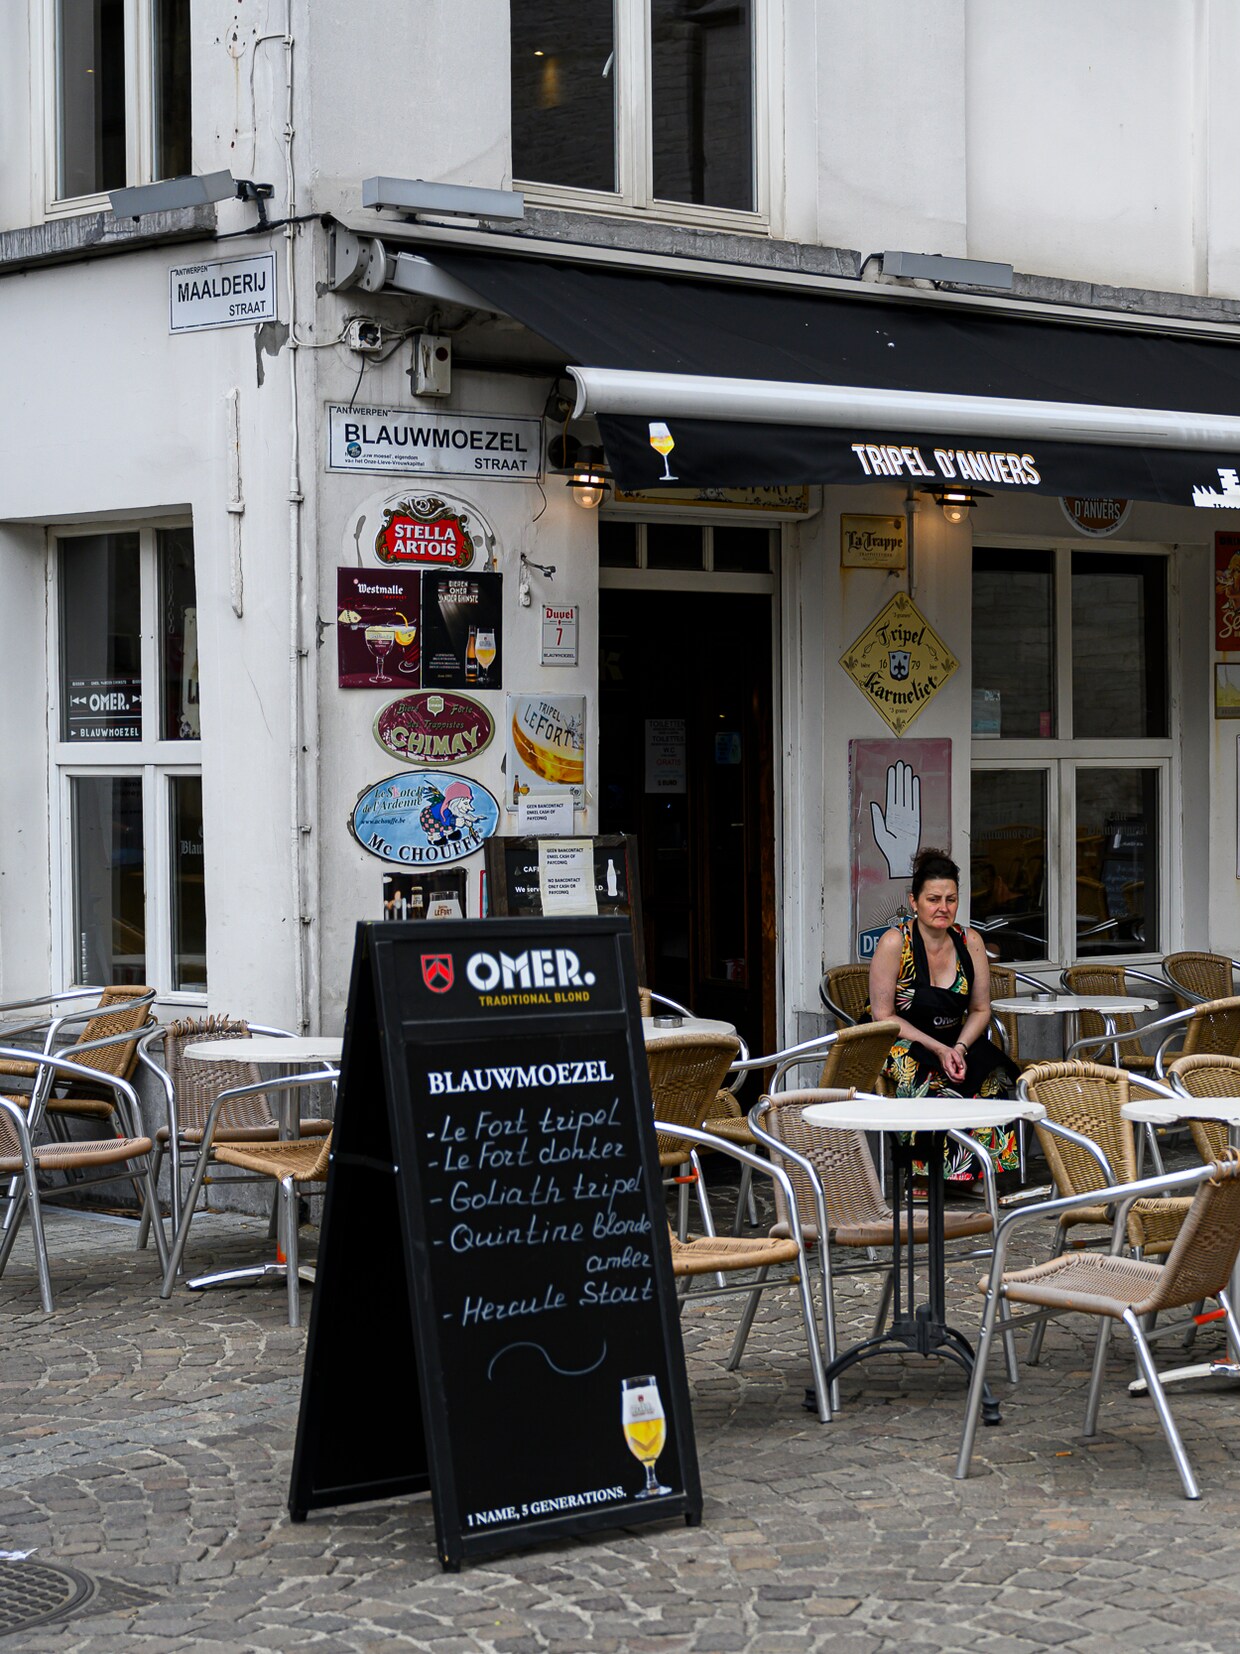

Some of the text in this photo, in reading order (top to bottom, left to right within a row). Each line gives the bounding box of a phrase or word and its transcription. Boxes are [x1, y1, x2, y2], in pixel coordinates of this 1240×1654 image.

[175, 264, 208, 277] ANTWERPEN
[178, 271, 266, 303] MAALDERIJ
[229, 300, 266, 317] STRAAT
[336, 406, 390, 417] ANTWERPEN
[345, 423, 528, 452] BLAUWMOEZEL
[474, 458, 528, 472] STRAAT
[851, 443, 1041, 486] TRIPEL D'ANVERS
[1074, 497, 1121, 520] D'ANVERS
[394, 523, 457, 542] STELLA
[845, 530, 904, 553] La Trappe
[393, 540, 457, 557] ARTOIS
[357, 583, 404, 595] Westmalle
[546, 607, 574, 619] Duvel
[556, 627, 563, 646] 7
[875, 619, 927, 648] Tripel
[880, 659, 888, 669] 16
[911, 660, 920, 670] 79
[859, 671, 937, 704] Karmeliet
[89, 692, 130, 712] OMER.
[539, 701, 561, 723] TRIPEL
[80, 727, 140, 738] BLAUWMOEZEL
[423, 719, 465, 730] Trappistes
[391, 724, 479, 756] CHIMAY
[374, 788, 386, 798] Le
[362, 798, 423, 814] de l'Ardenne
[368, 831, 484, 862] Mc CHOUFFE
[466, 948, 596, 992] OMER.
[479, 991, 590, 1007] TRADITIONAL BLOND
[428, 1060, 614, 1095] BLAUWMOEZEL
[440, 1097, 622, 1150] Le Fort tripel
[444, 1136, 626, 1171] Le Fort donker
[573, 1165, 644, 1215] tripel
[450, 1214, 584, 1253] Quintine
[586, 1246, 653, 1273] amber
[579, 1278, 654, 1306] Stout
[475, 1506, 521, 1526] NAME,
[521, 1503, 529, 1518] 5
[530, 1486, 627, 1515] GENERATIONS.
